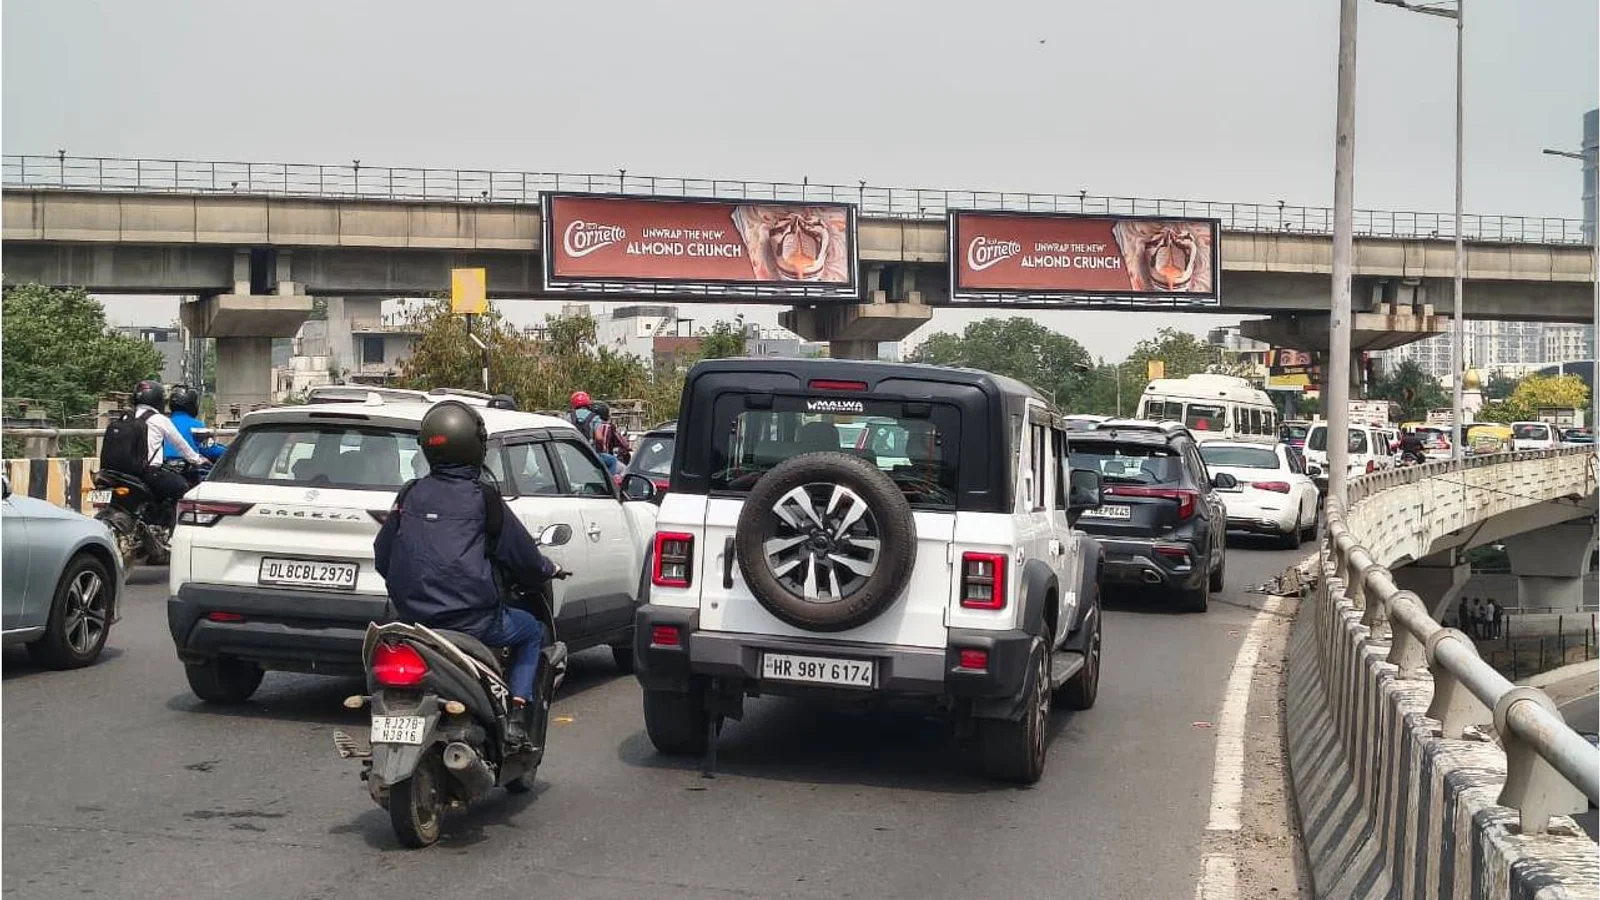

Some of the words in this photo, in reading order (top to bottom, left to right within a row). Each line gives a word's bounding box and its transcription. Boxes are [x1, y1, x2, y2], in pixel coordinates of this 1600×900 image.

[564, 220, 627, 258] Cornetto
[642, 228, 681, 239] UNWRAP
[684, 229, 700, 240] THE
[626, 241, 684, 255] ALMOND
[687, 243, 742, 257] CRUNCH
[967, 236, 1021, 271] Cornetto
[1034, 242, 1070, 253] UNWRAP
[1071, 243, 1085, 253] THE
[1021, 255, 1071, 268] ALMOND
[1073, 256, 1121, 269] CRUNCH
[269, 563, 354, 583] DL8CBL2979
[773, 658, 792, 677] HR
[798, 661, 826, 679] 98Y
[831, 664, 870, 683] 6174
